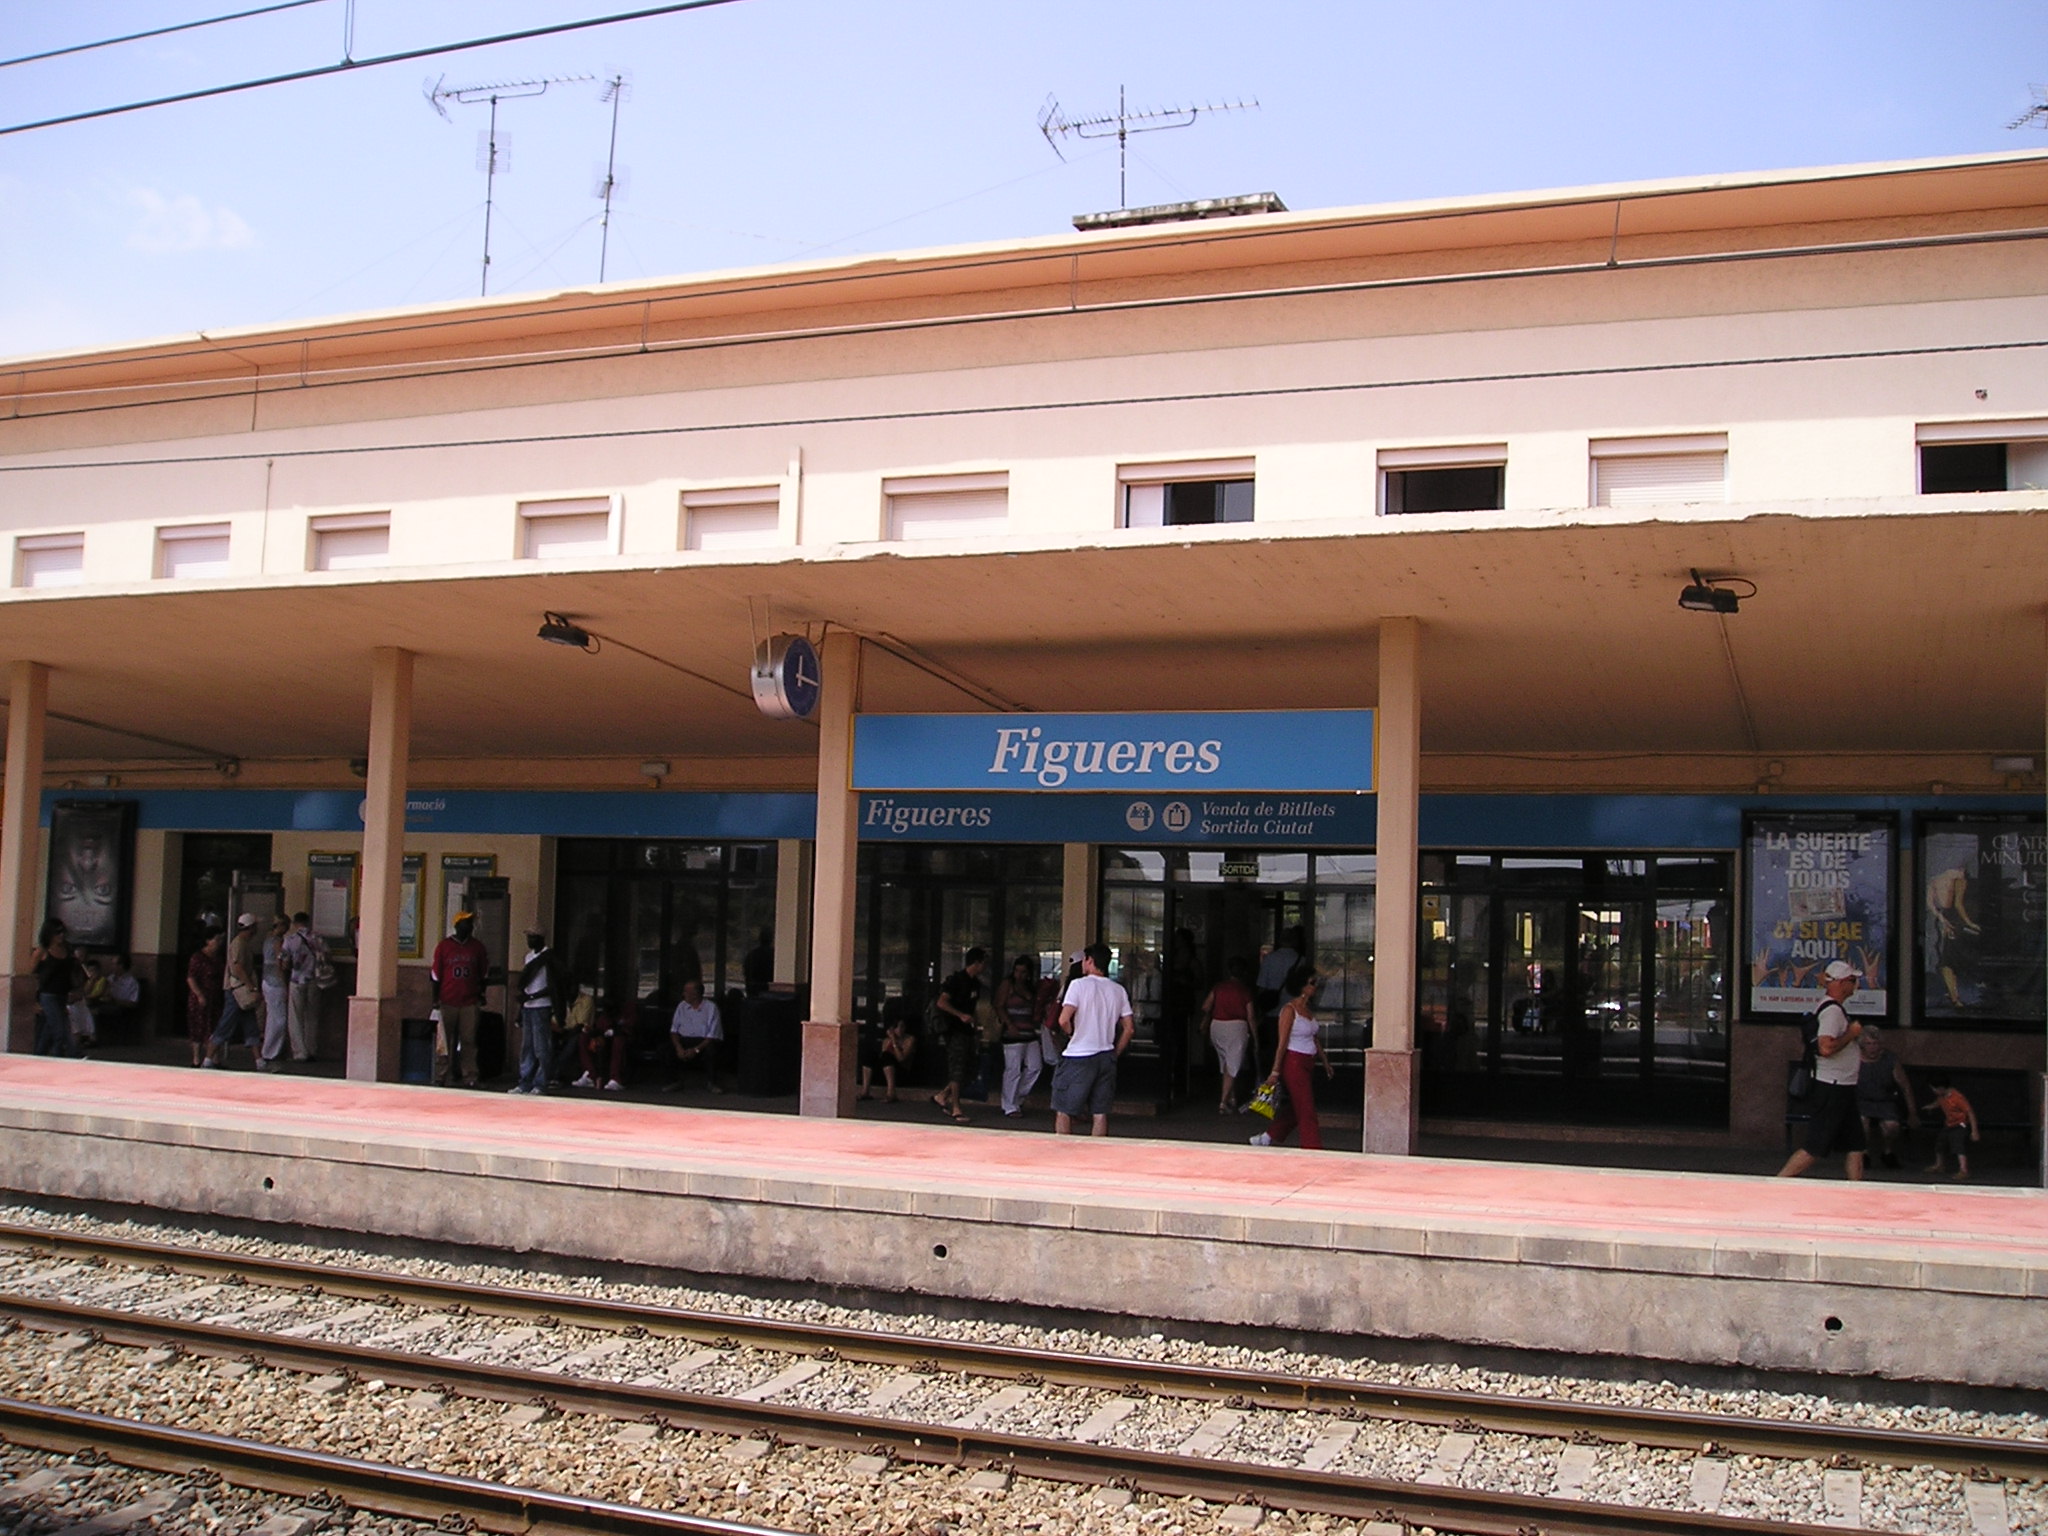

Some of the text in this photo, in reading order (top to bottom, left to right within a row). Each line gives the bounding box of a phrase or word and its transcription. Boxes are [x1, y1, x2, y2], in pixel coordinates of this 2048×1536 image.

[988, 726, 1222, 787] Figueres
[406, 798, 446, 811] rmació
[1202, 802, 1336, 818] Venda de Bitllets
[864, 799, 992, 831] Figueres
[1200, 820, 1314, 835] Sortida Ciutat
[1766, 832, 1872, 851] LA SUERTE
[1992, 834, 2047, 850] CUATR
[1222, 864, 1257, 875] SORTIDA
[1790, 851, 1847, 870] ES DE
[1785, 869, 1850, 888] TODOS
[1799, 921, 1818, 939] SI
[1824, 921, 1863, 940] CAE
